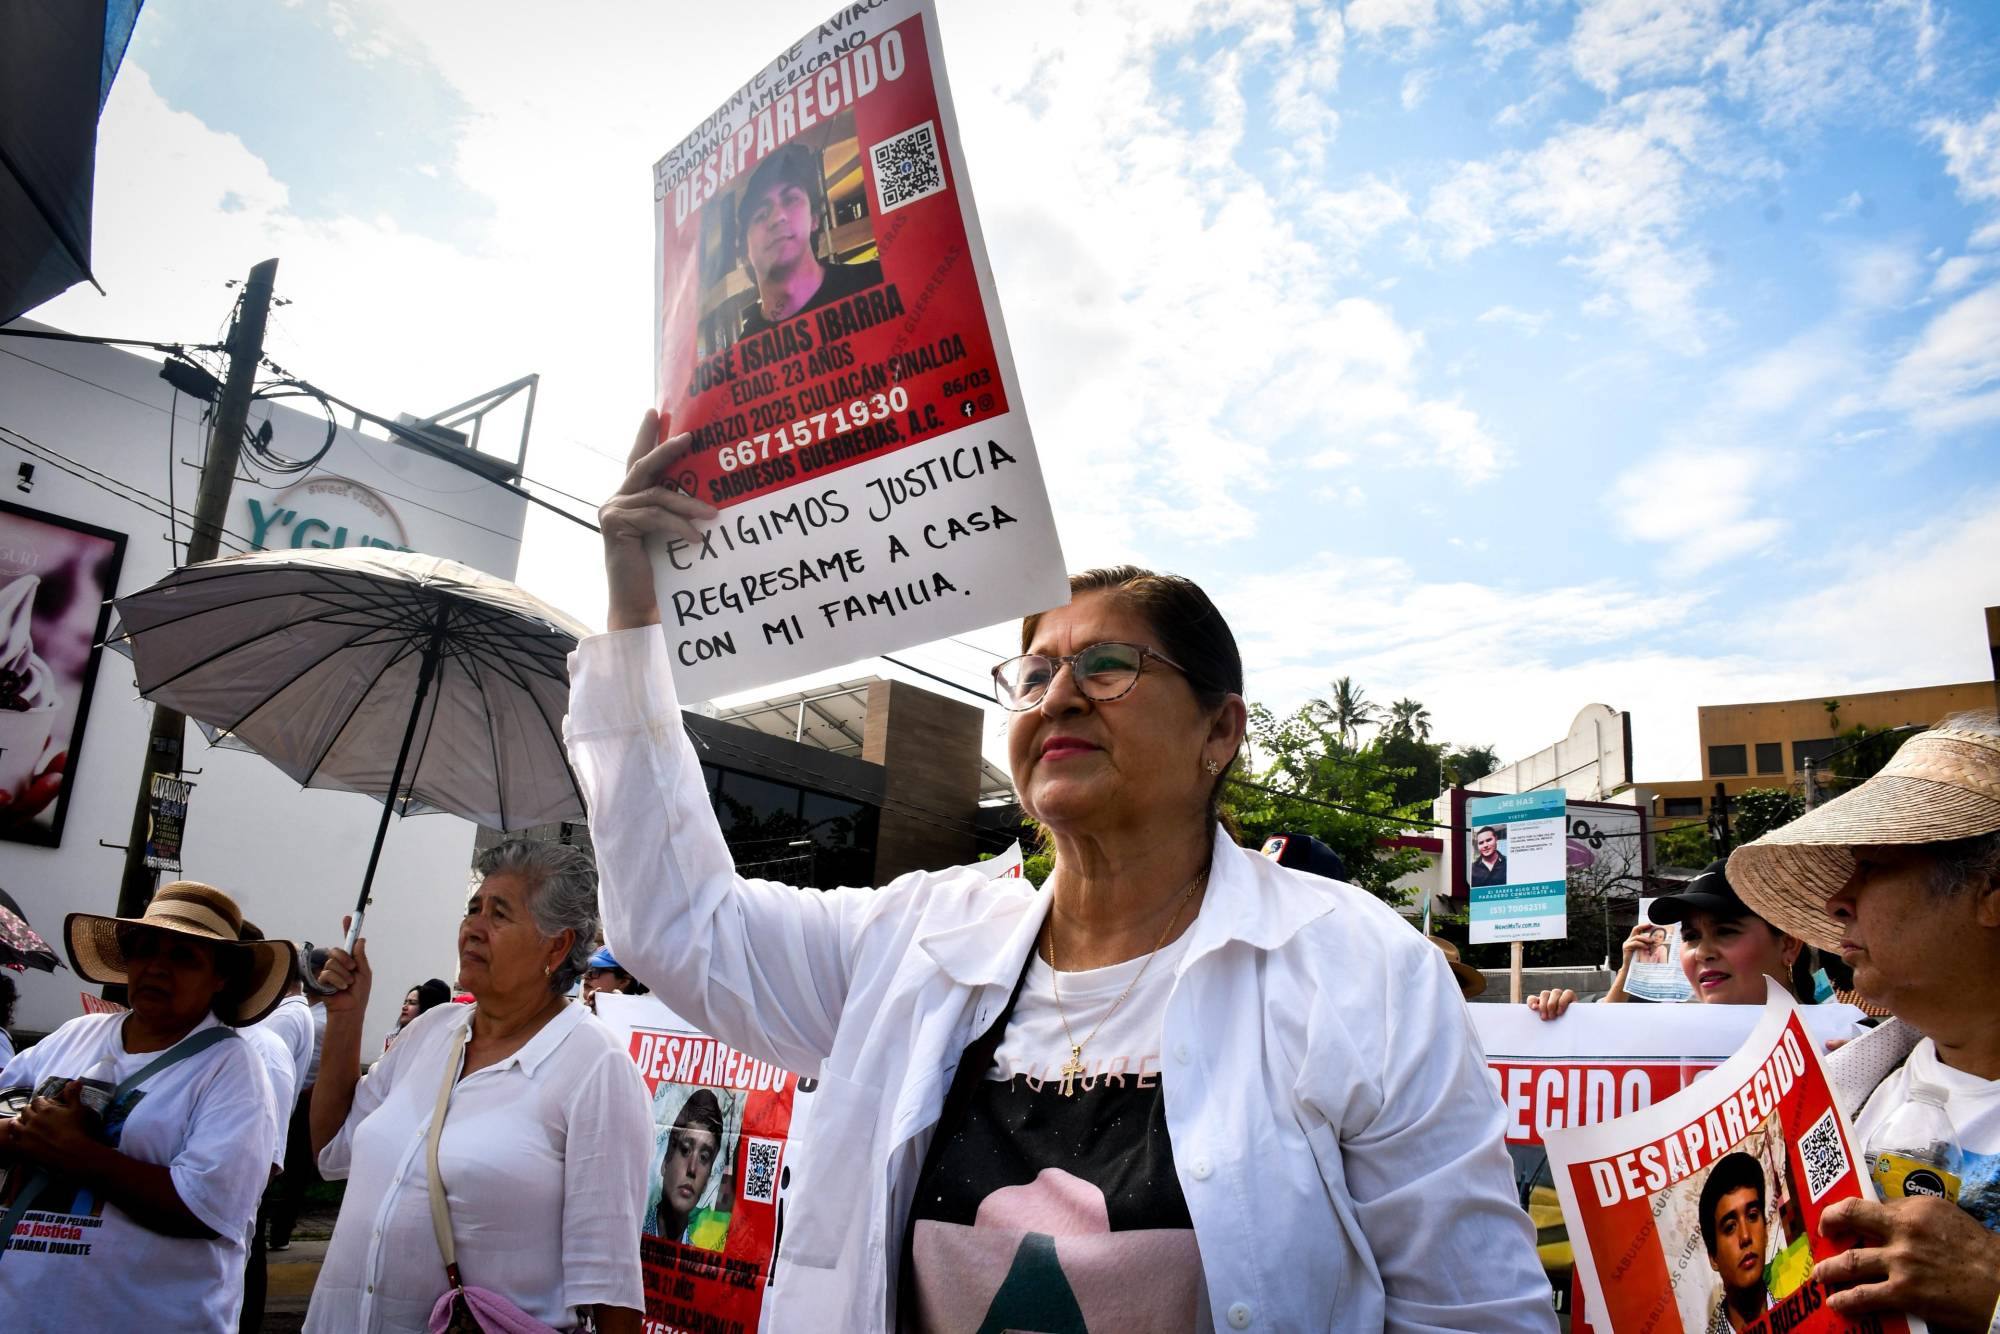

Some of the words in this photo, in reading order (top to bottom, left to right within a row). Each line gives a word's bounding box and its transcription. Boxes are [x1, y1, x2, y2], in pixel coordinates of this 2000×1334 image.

[749, 30, 866, 117] AMERICANO
[777, 40, 803, 74] DE
[674, 29, 906, 228] DESAPARECIDO
[818, 283, 906, 347] IBARRA
[690, 413, 748, 455] MARZO
[750, 398, 797, 433] 2025
[798, 363, 887, 418] CULIACÁN
[887, 333, 968, 381] SINALOA
[731, 372, 781, 406] EDAD:
[781, 360, 806, 387] 23
[809, 341, 855, 378] AÑOS
[942, 367, 992, 398] 86/03
[708, 454, 796, 503] SABUESOS
[799, 422, 907, 473] GUERRERAS,
[909, 404, 945, 434] A.C.
[718, 386, 909, 472] 6671571930
[666, 489, 850, 570] EXIGIMOS
[865, 440, 1016, 522] JUSTICIA
[671, 549, 866, 627] REGRESAME
[889, 534, 910, 564] A
[923, 504, 1018, 550] CASA
[677, 630, 738, 667] CON
[762, 614, 805, 647] MI
[637, 1035, 787, 1093] DESAPARECIDO
[1590, 1027, 1806, 1208] DESAPARECIDO
[1905, 1180, 1944, 1199] Grand
[13, 1240, 48, 1253] IBARRA
[48, 1241, 92, 1256] DUARTE
[31, 1222, 83, 1241] justicia
